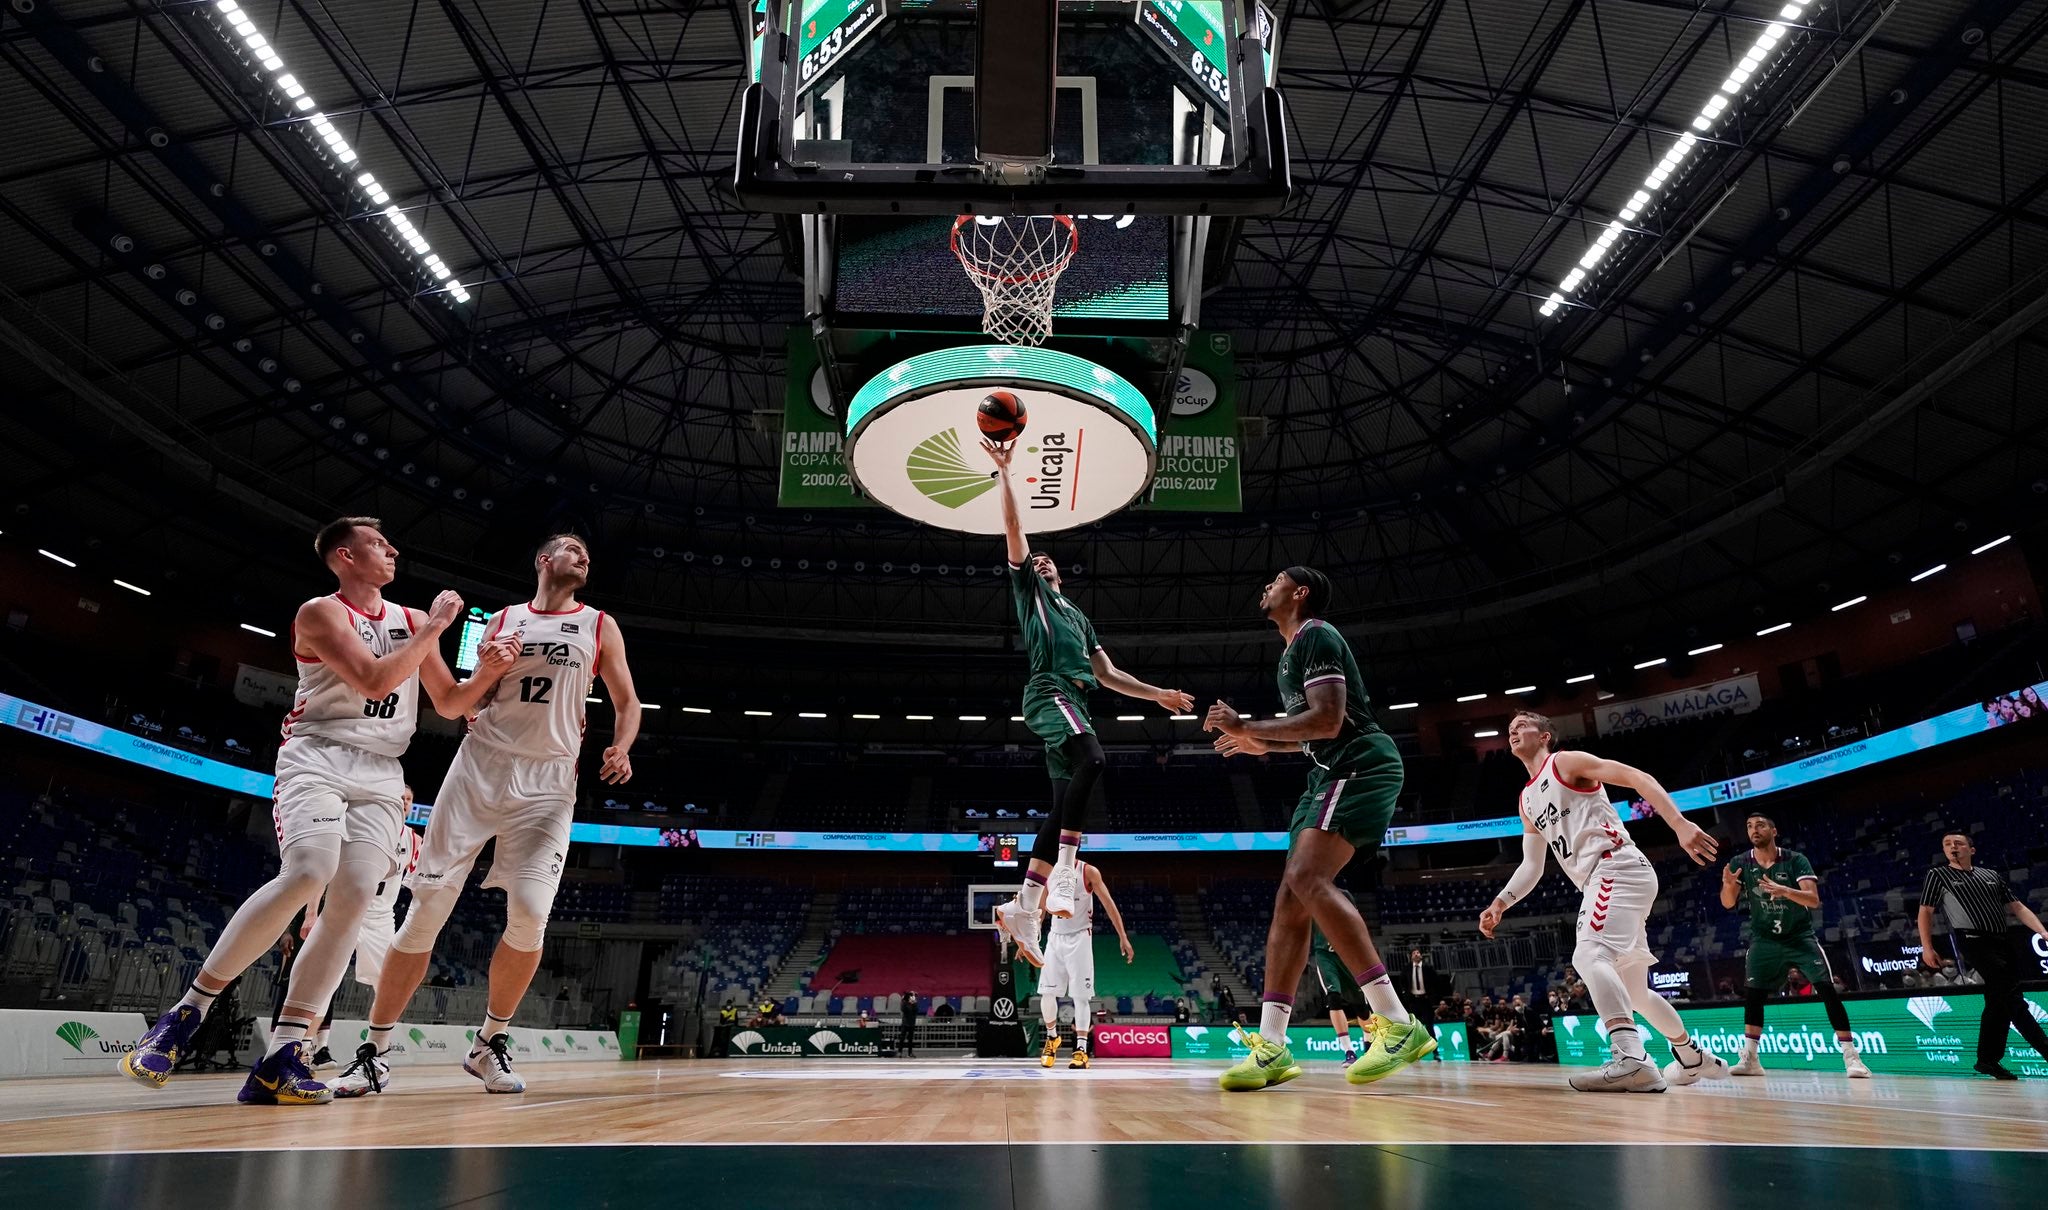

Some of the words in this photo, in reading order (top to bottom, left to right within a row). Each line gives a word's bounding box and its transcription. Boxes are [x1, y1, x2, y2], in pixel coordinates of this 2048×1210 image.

[1203, 29, 1214, 46] 3
[801, 26, 843, 80] 6:53
[1191, 50, 1230, 102] 6:53
[789, 453, 830, 466] COPA
[1026, 432, 1074, 510] Unicaja
[1154, 476, 1218, 491] 2016/2017
[548, 655, 581, 669] bet.es
[519, 675, 553, 704] 12
[131, 737, 189, 764] COMPROMETIDOS
[188, 755, 204, 768] CON
[1798, 747, 1853, 770] COMPROMETIDOS
[1852, 743, 1868, 754] CON
[1456, 820, 1513, 831] COMPROMETIDOS
[822, 833, 873, 842] COMPROMETIDOS
[873, 834, 888, 842] CON
[1001, 847, 1012, 861] 8
[1771, 919, 1783, 935] 3
[1652, 971, 1690, 985] Europcar
[1098, 1028, 1169, 1045] endesa
[1306, 1036, 1366, 1052] fundci
[1915, 1034, 1962, 1046] Fundación
[761, 1042, 802, 1055] Unicaja
[838, 1042, 879, 1055] Unicaja
[1925, 1050, 1960, 1065] Unicaja
